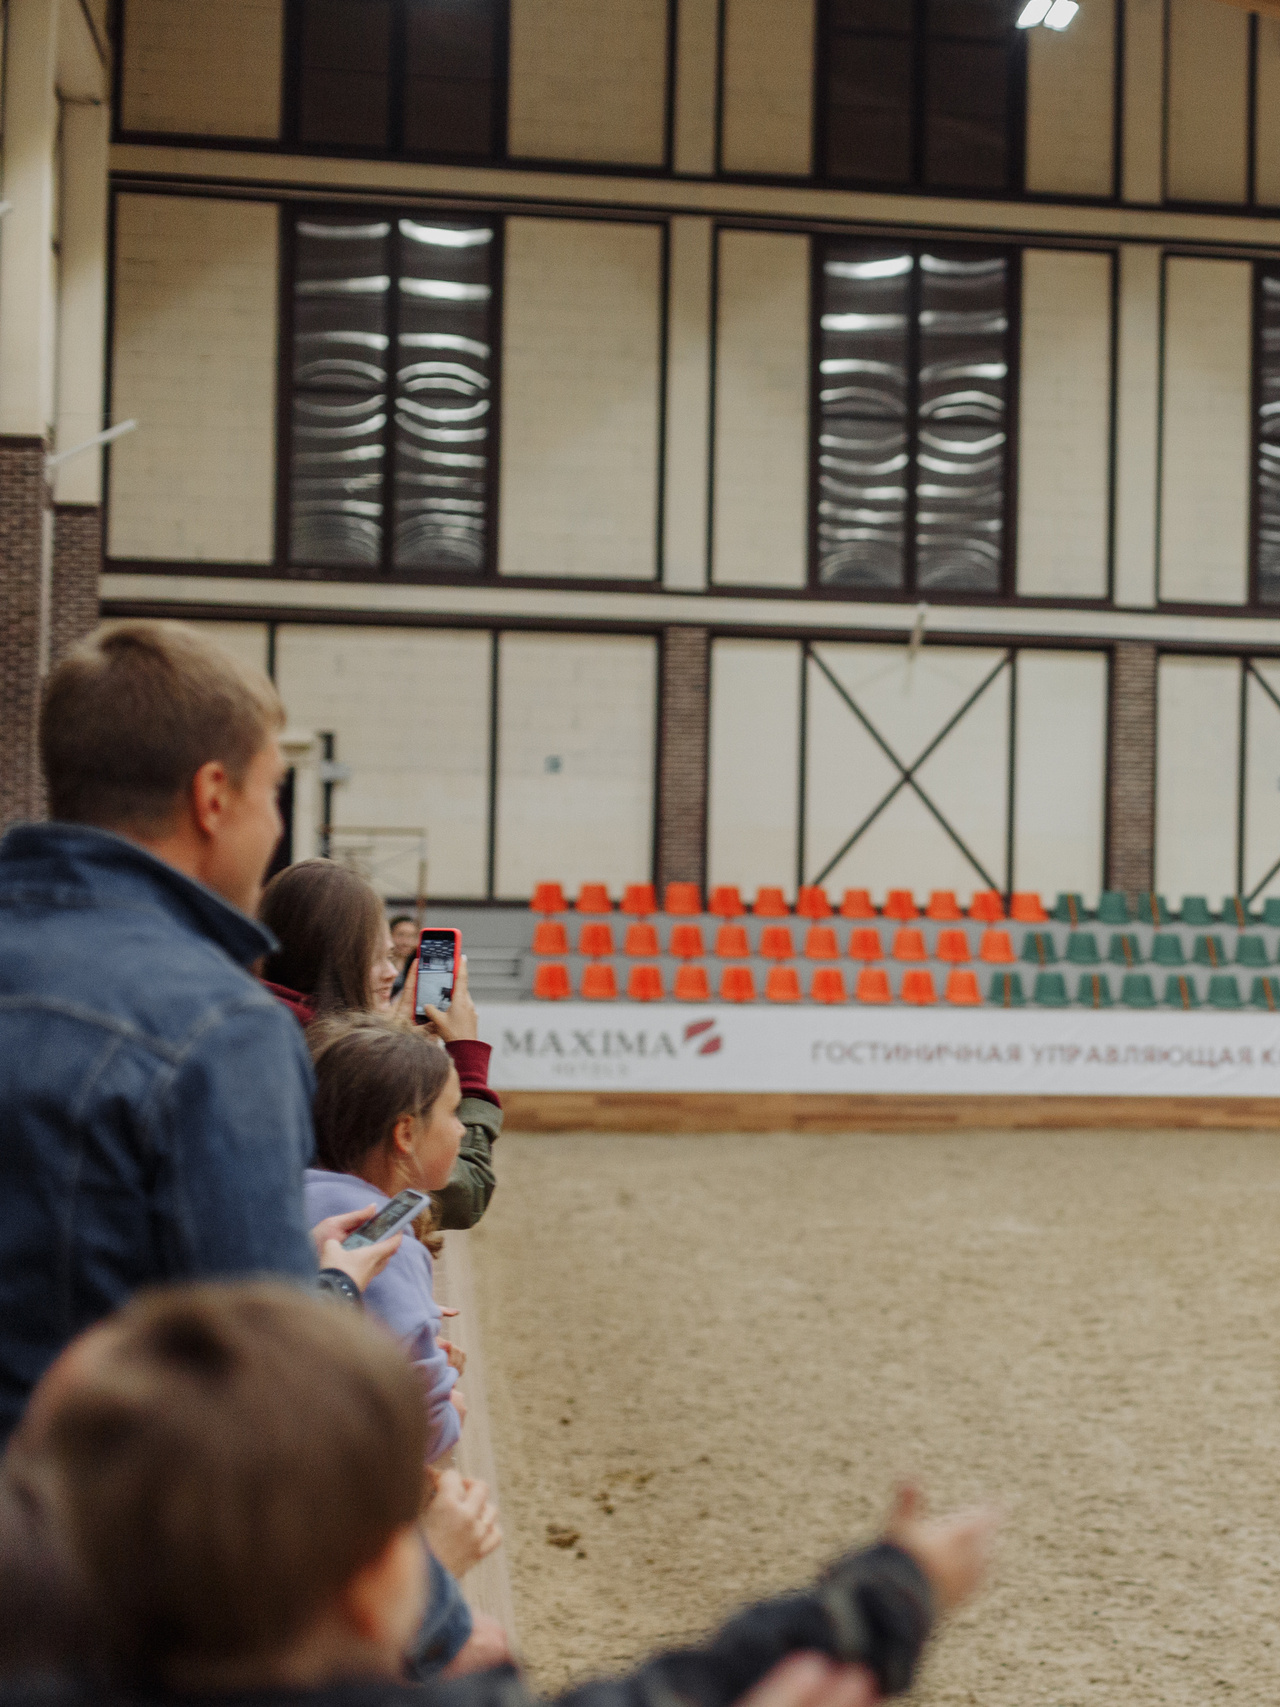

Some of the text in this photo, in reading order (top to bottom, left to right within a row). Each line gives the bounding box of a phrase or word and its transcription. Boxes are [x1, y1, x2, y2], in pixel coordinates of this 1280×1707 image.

[502, 1028, 678, 1058] MAXIMA
[810, 1040, 1022, 1066] ГОСТИНИЧНАЯ
[1030, 1042, 1254, 1070] УПРАВЛЯЮЩАЯ
